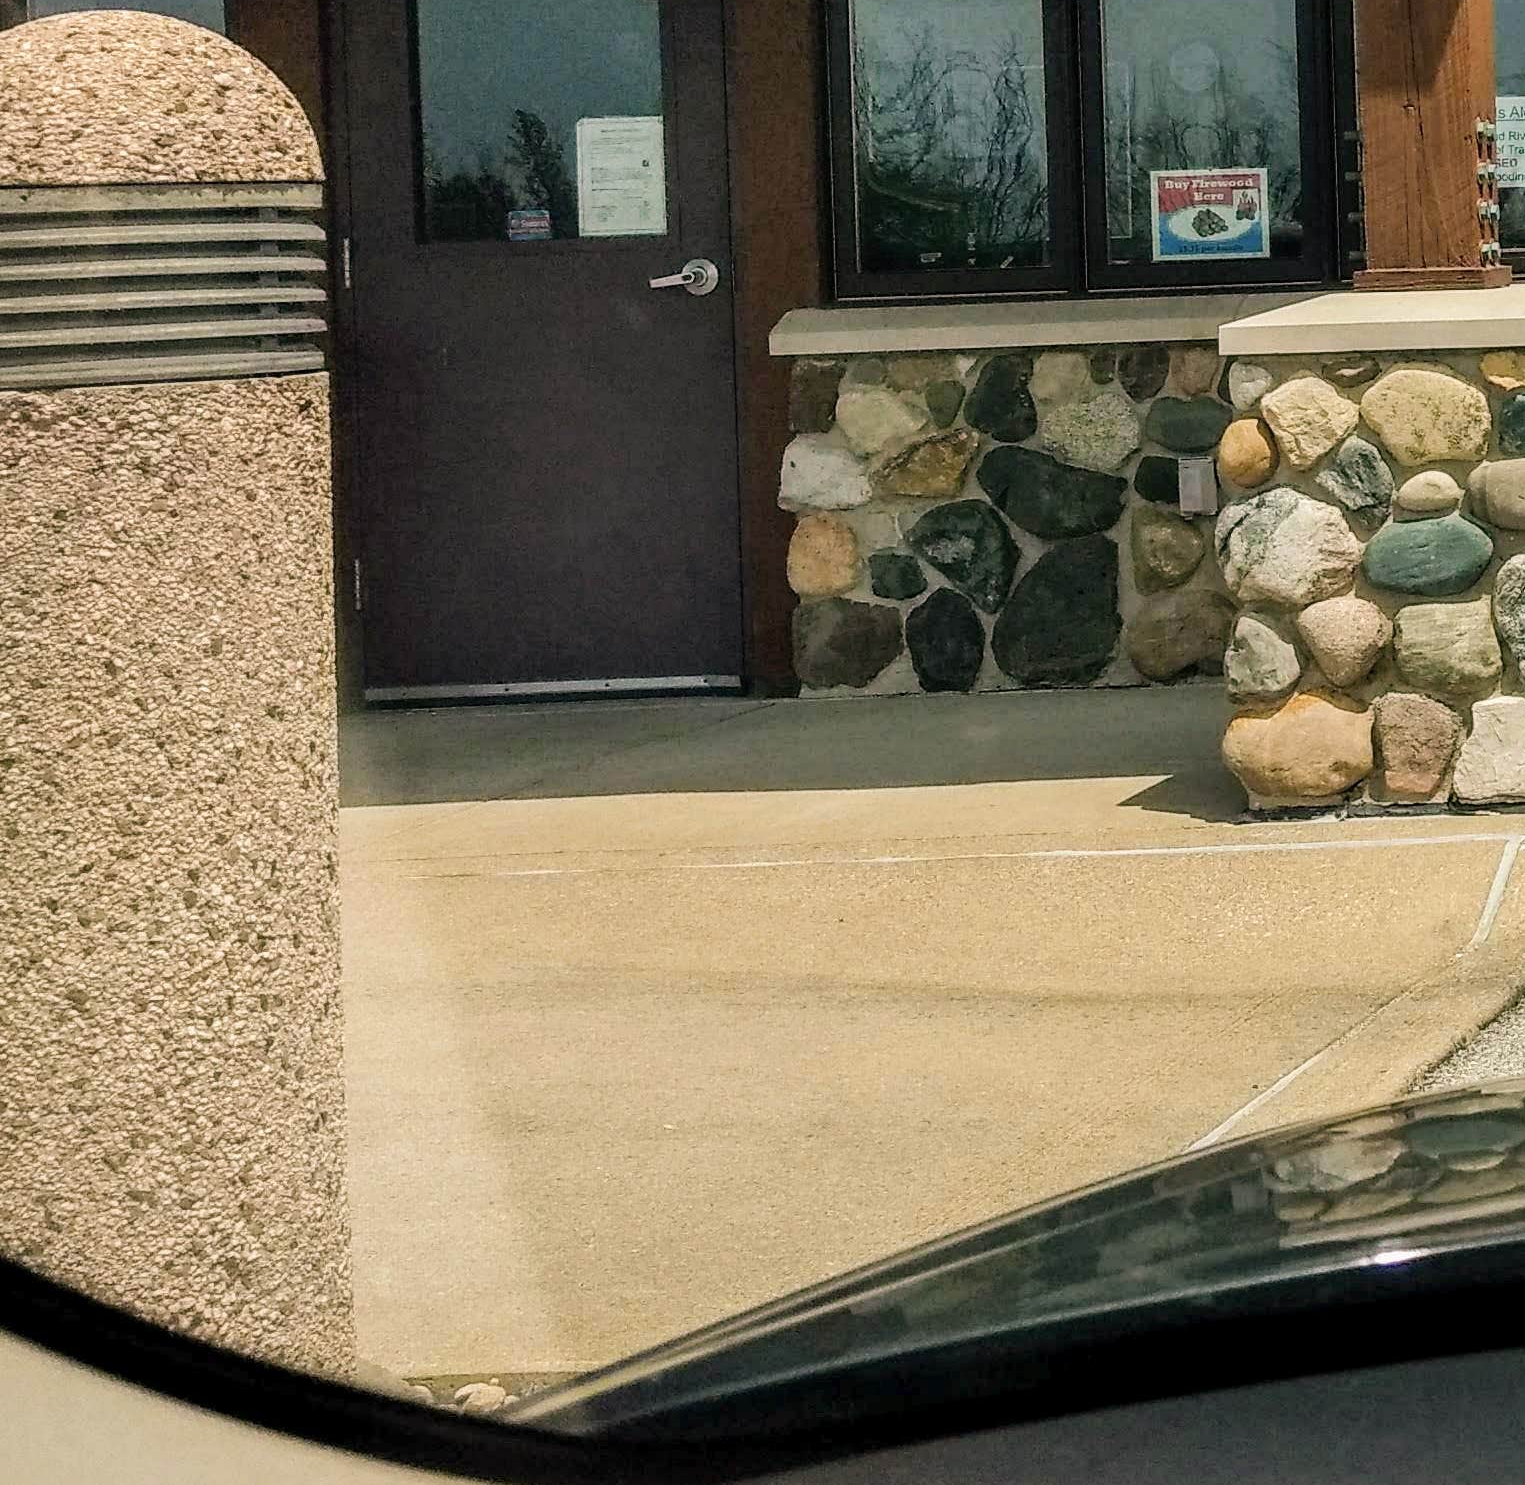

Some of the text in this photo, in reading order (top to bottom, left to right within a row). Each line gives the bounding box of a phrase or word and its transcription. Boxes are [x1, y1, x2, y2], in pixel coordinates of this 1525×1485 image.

[1165, 178, 1254, 190] Buy Firewood
[1194, 192, 1225, 201] Here
